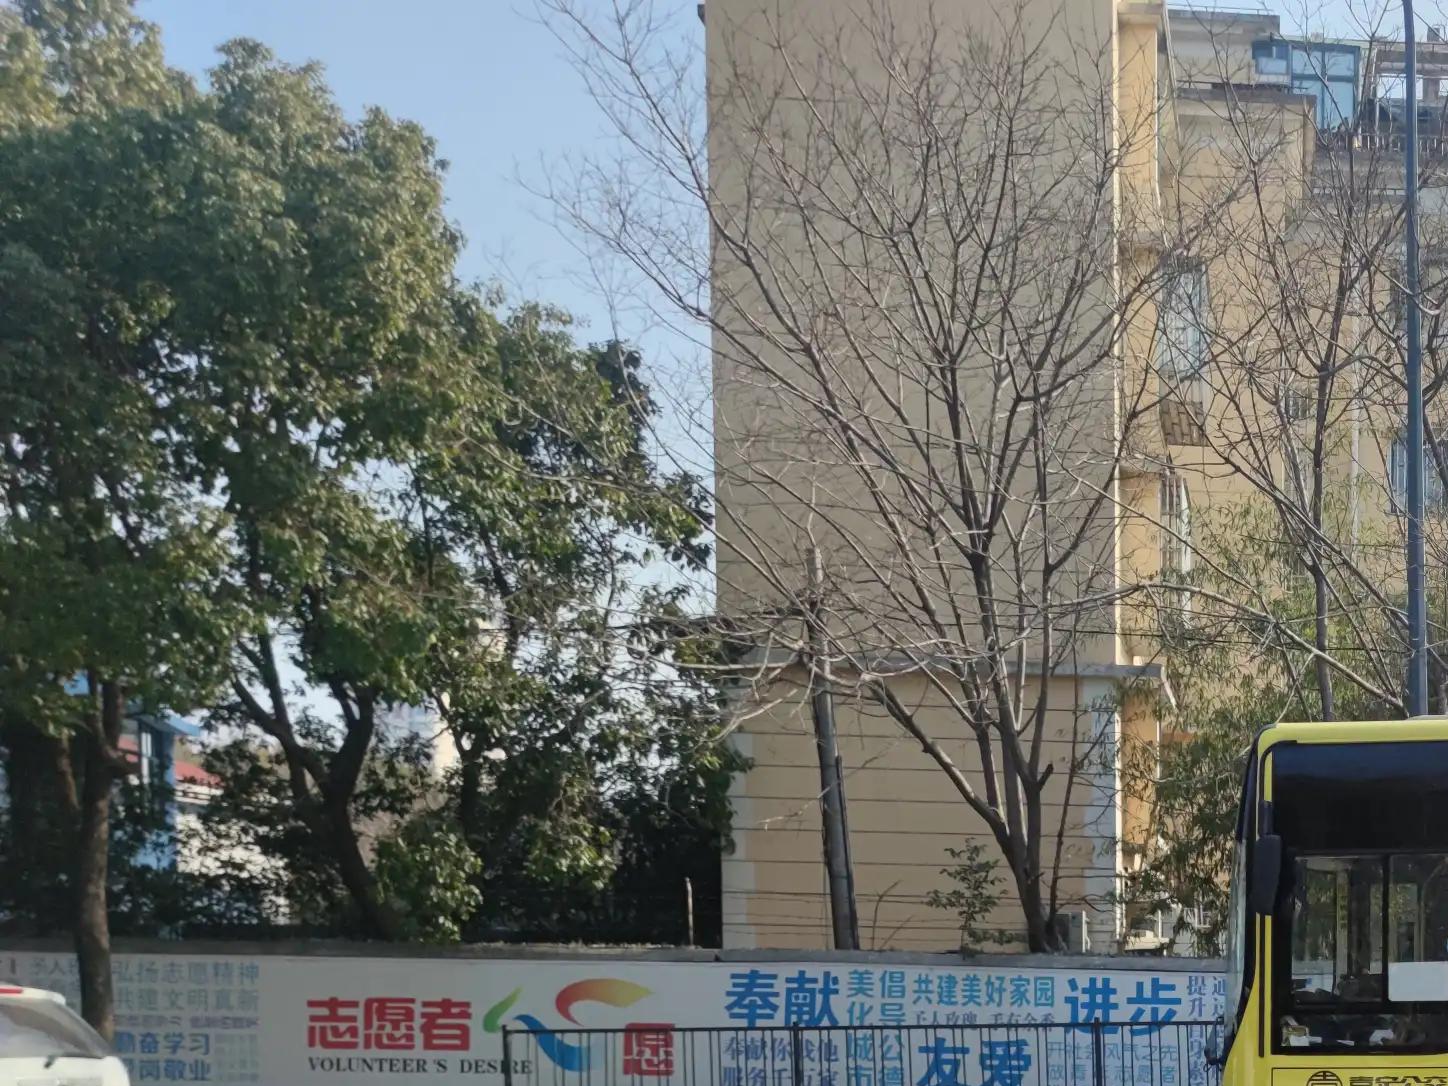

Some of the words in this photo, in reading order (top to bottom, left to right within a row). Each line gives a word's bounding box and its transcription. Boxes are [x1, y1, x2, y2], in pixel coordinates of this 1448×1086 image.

[725, 970, 839, 1028] 奉献
[913, 973, 1055, 1007] 共建美好家园
[1064, 977, 1182, 1037] 进步
[307, 997, 471, 1051] 志愿者
[624, 1023, 676, 1077] 愿
